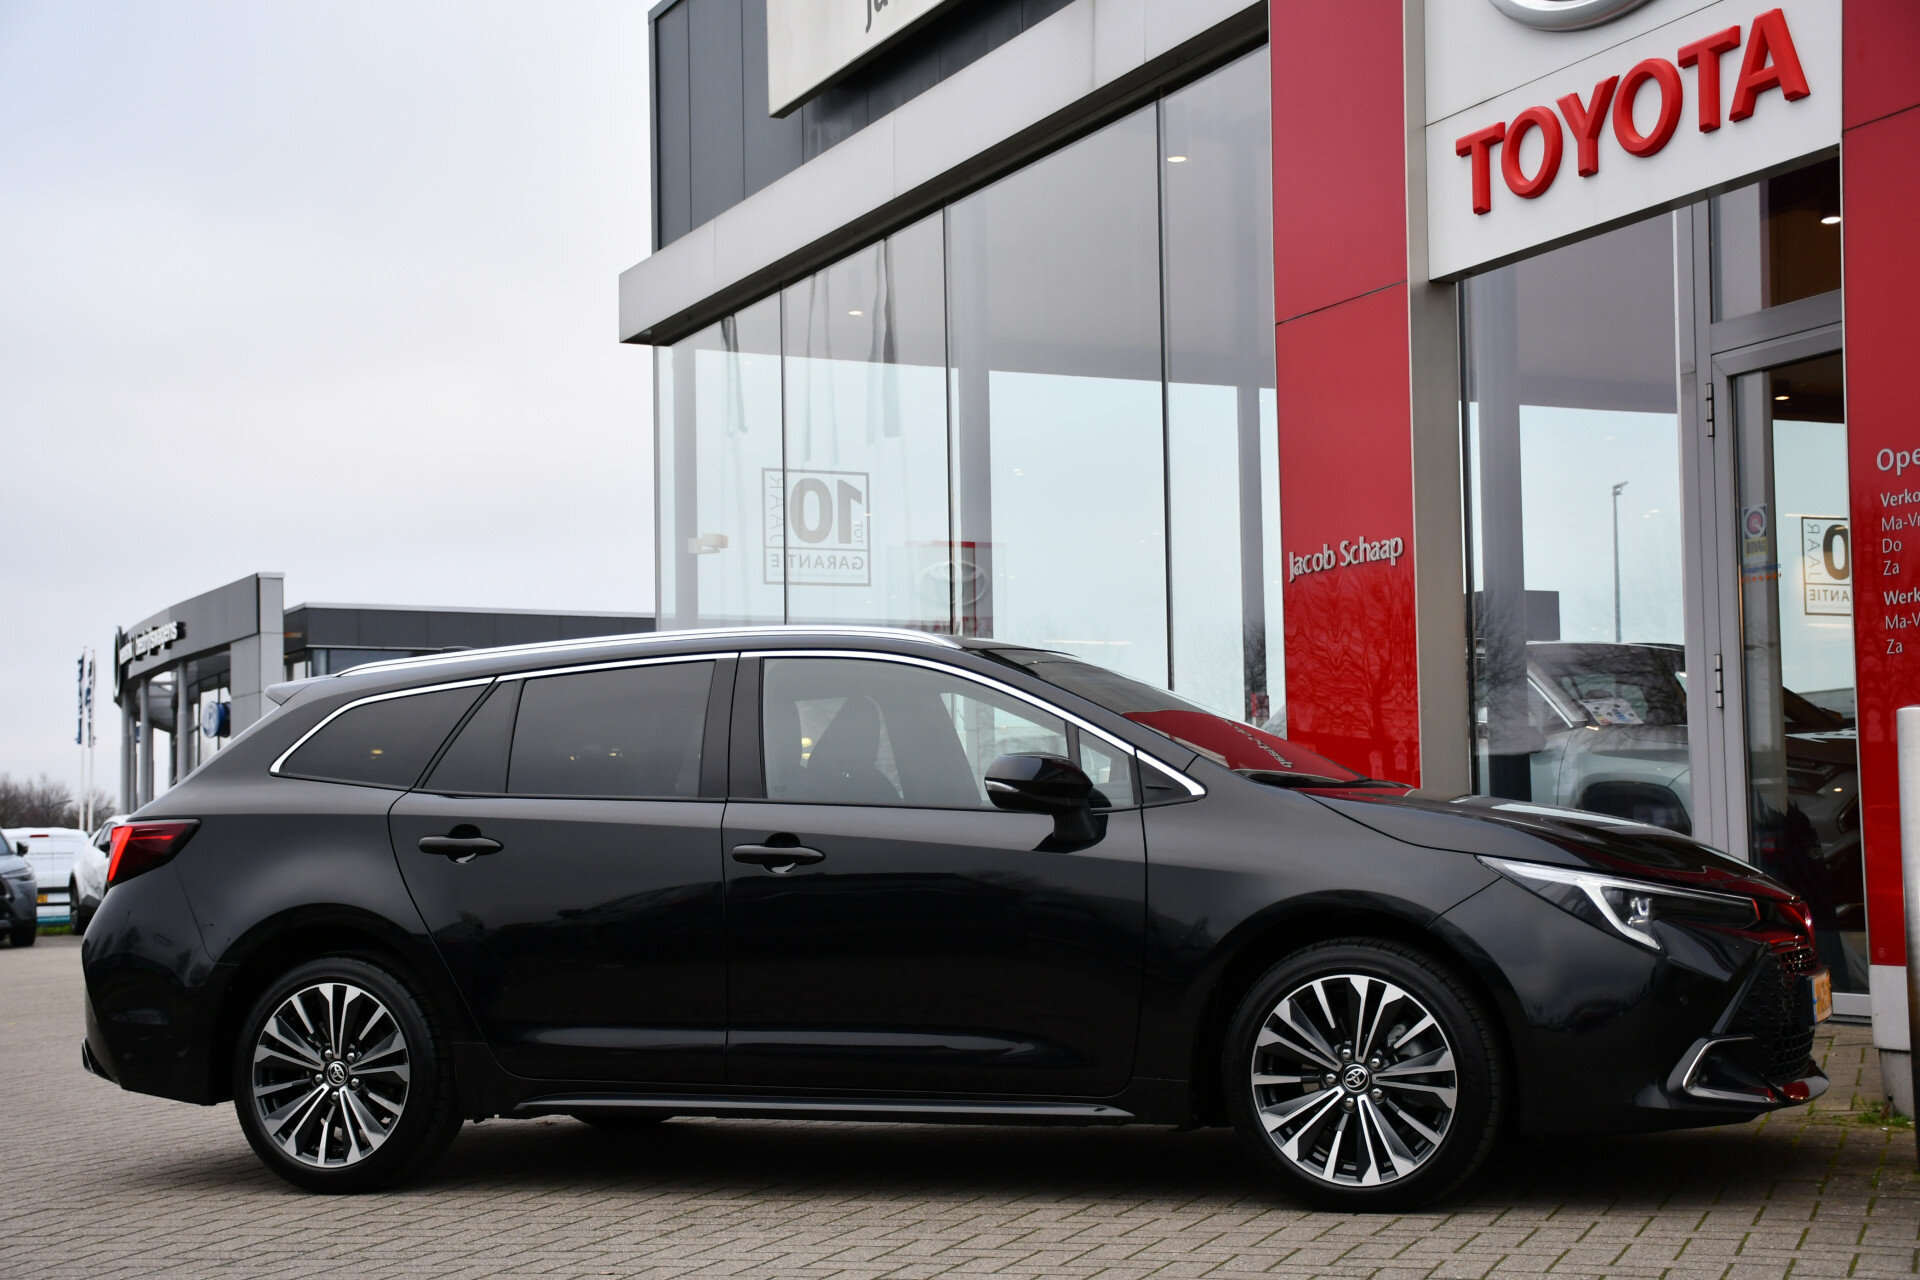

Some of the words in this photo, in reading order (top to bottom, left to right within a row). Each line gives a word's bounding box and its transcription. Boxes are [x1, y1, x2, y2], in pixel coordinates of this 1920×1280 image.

[1455, 8, 1811, 215] TOYOTA
[1882, 538, 1902, 554] Do
[1288, 543, 1337, 583] Jacob
[1339, 535, 1404, 567] Schaap
[1883, 560, 1900, 576] Za
[1886, 638, 1903, 655] Za
